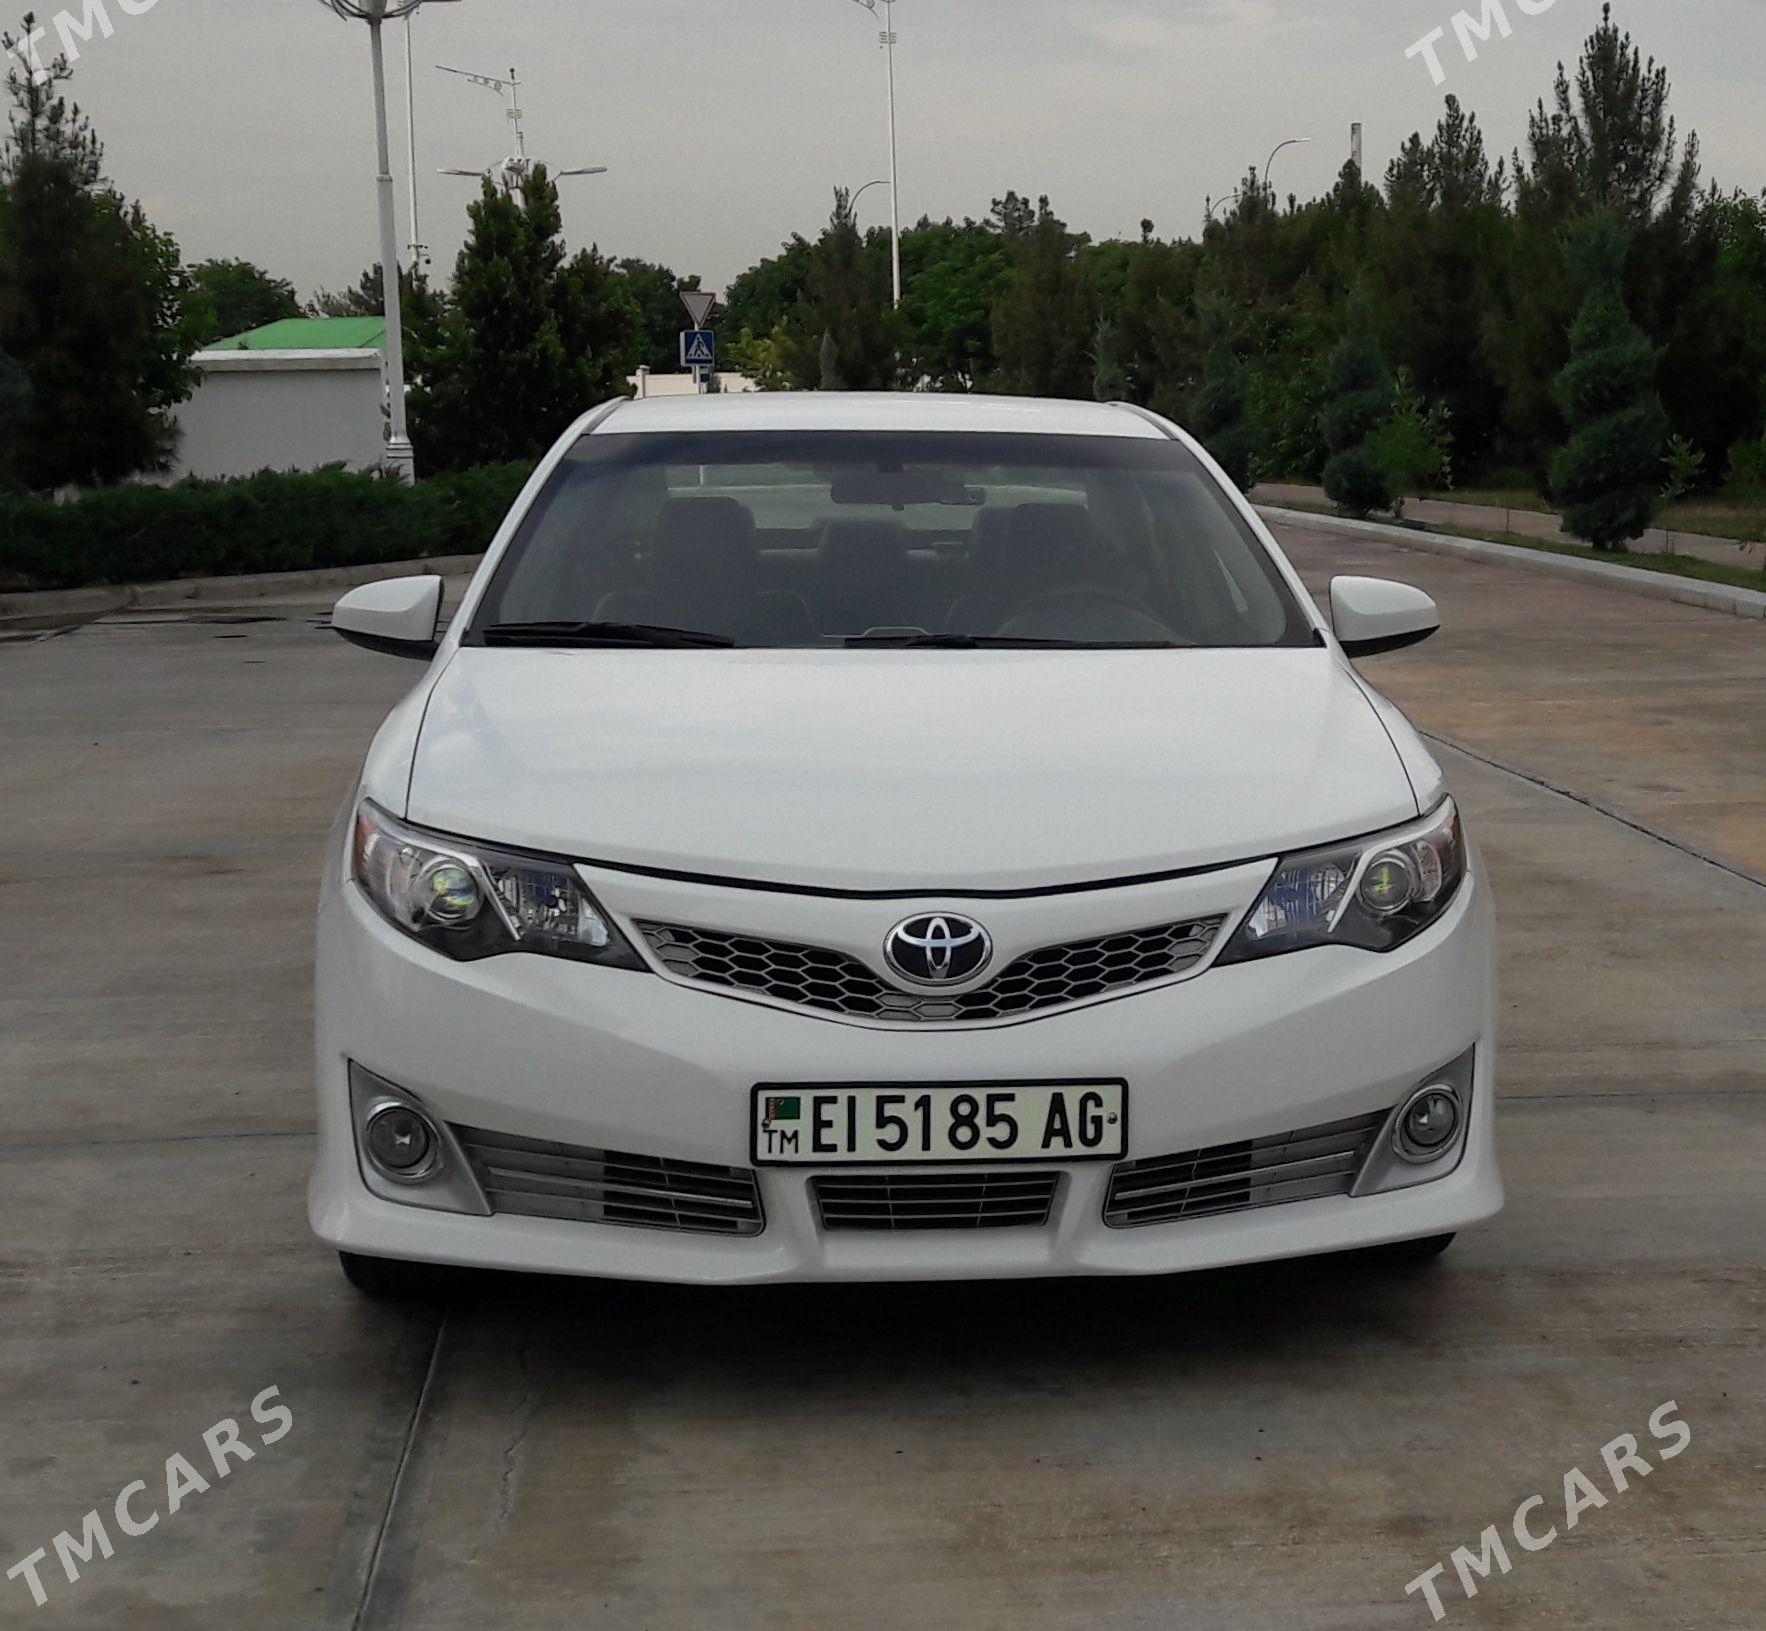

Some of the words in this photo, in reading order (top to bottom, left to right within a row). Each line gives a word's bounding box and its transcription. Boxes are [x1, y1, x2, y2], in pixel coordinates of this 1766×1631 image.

[763, 1129, 799, 1154] TM
[812, 1095, 856, 1153] EI
[875, 1093, 1019, 1151] 5185
[1041, 1091, 1104, 1149] AG
